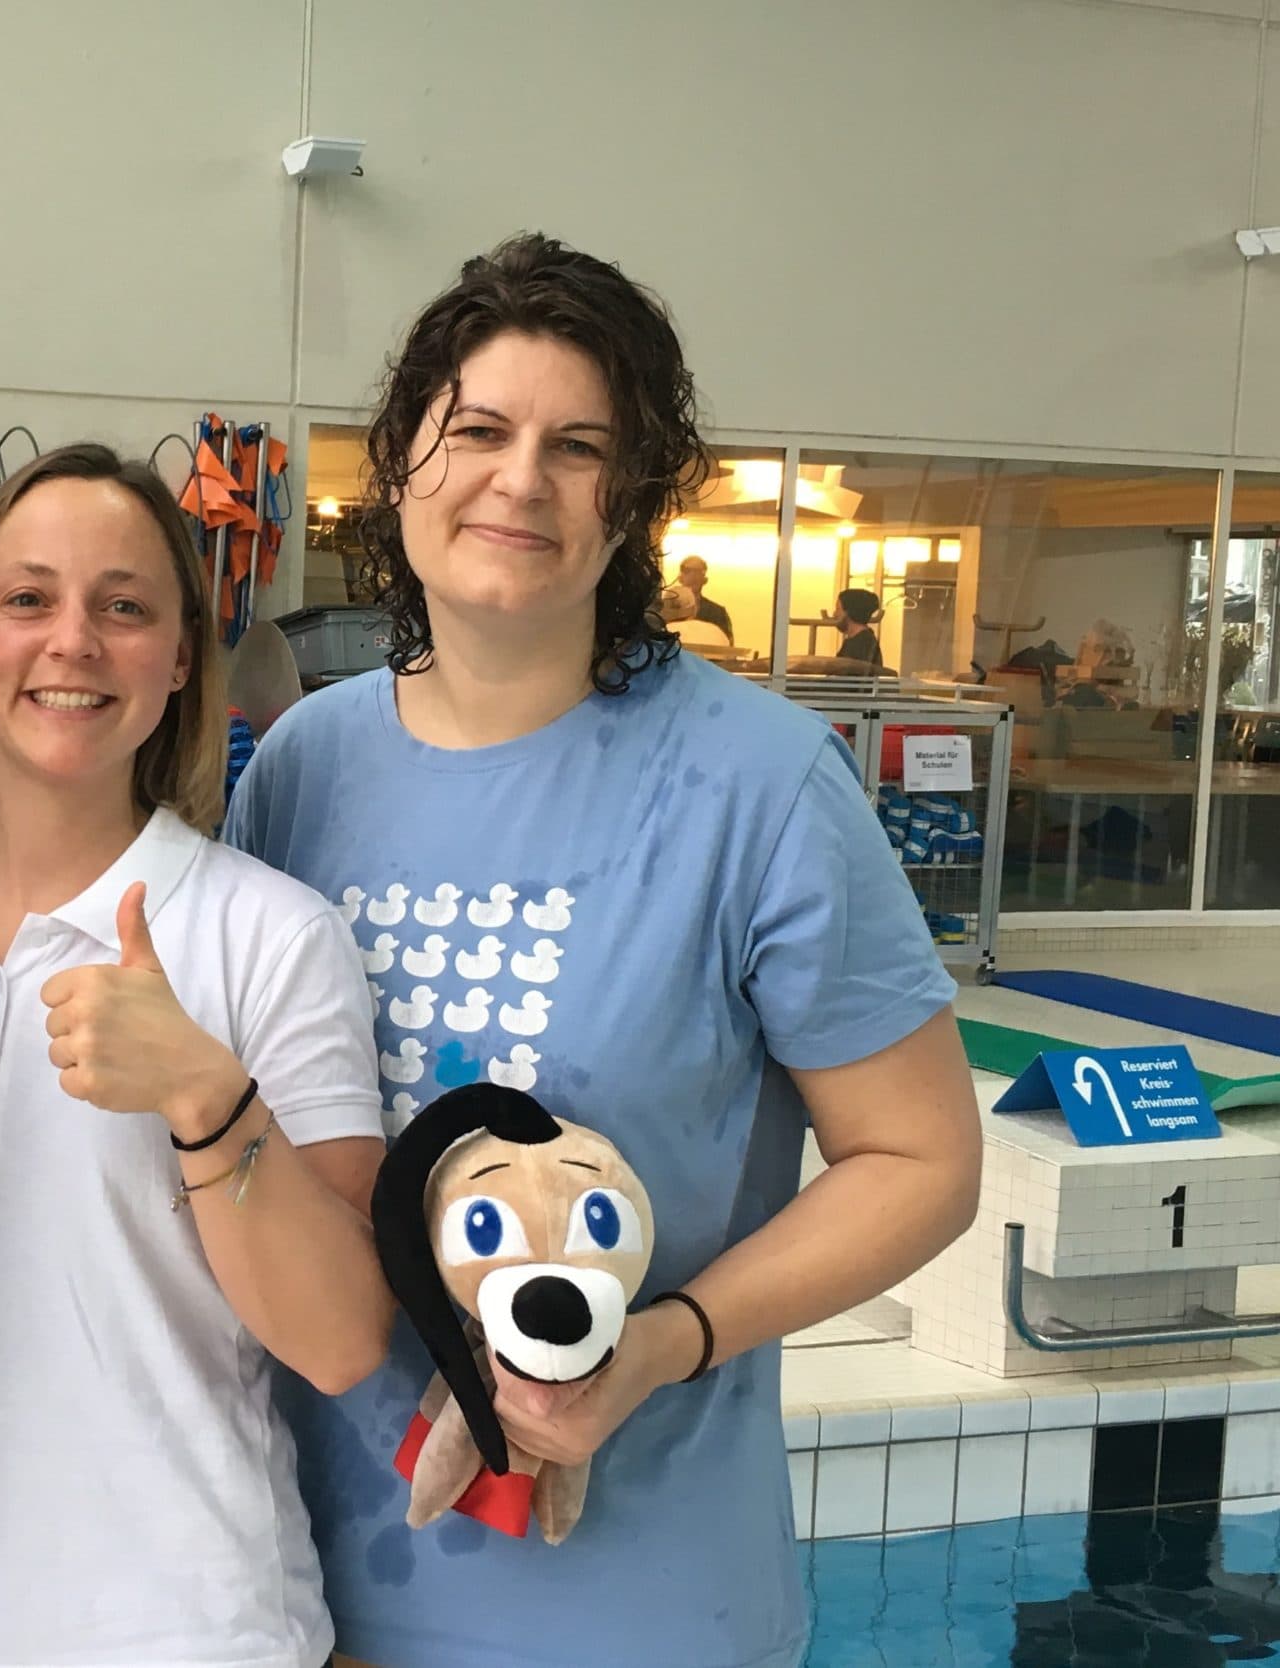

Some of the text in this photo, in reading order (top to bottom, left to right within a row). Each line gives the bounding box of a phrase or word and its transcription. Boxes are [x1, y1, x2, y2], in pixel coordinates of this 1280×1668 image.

[915, 751, 946, 759] Material
[921, 761, 953, 769] Schulen
[1120, 1058, 1178, 1073] Reserviert
[1139, 1076, 1174, 1090] Kreis-
[1131, 1095, 1199, 1110] schwimmen
[1145, 1113, 1199, 1130] langsam
[1161, 1185, 1187, 1249] 1
